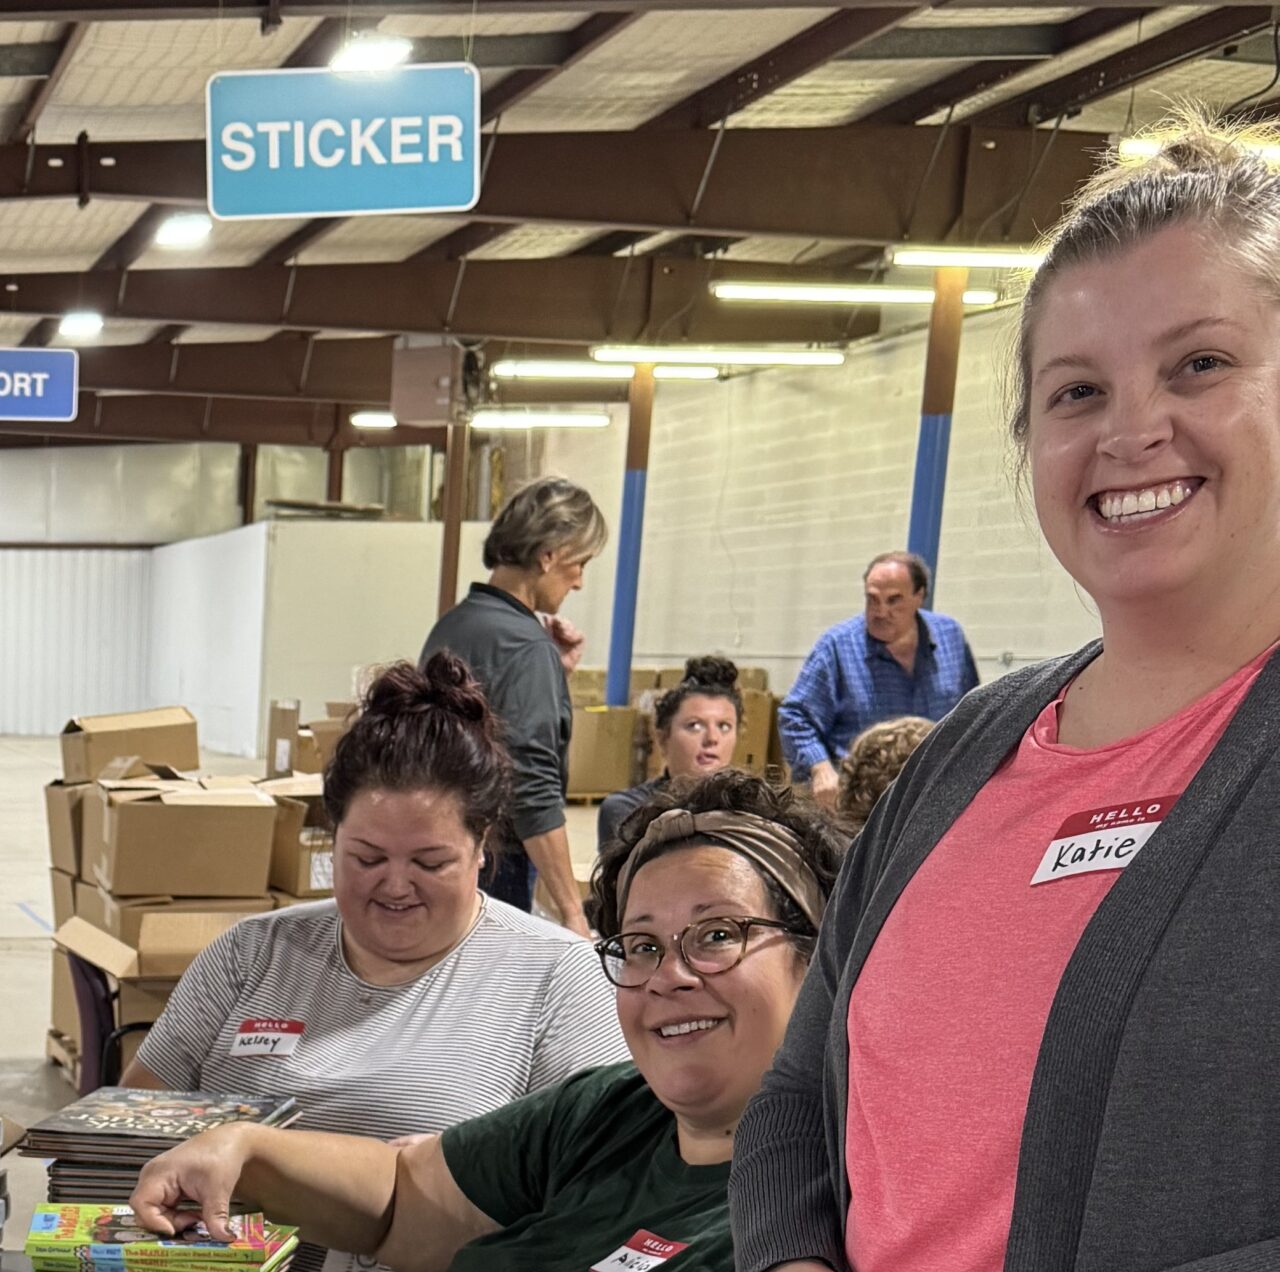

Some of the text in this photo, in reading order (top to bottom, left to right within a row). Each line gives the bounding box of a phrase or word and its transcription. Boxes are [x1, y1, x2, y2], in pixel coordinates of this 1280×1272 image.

[220, 115, 464, 171] STICKER
[1089, 804, 1161, 824] HELLO
[1051, 838, 1136, 872] Katie
[643, 1238, 674, 1252] HELLO
